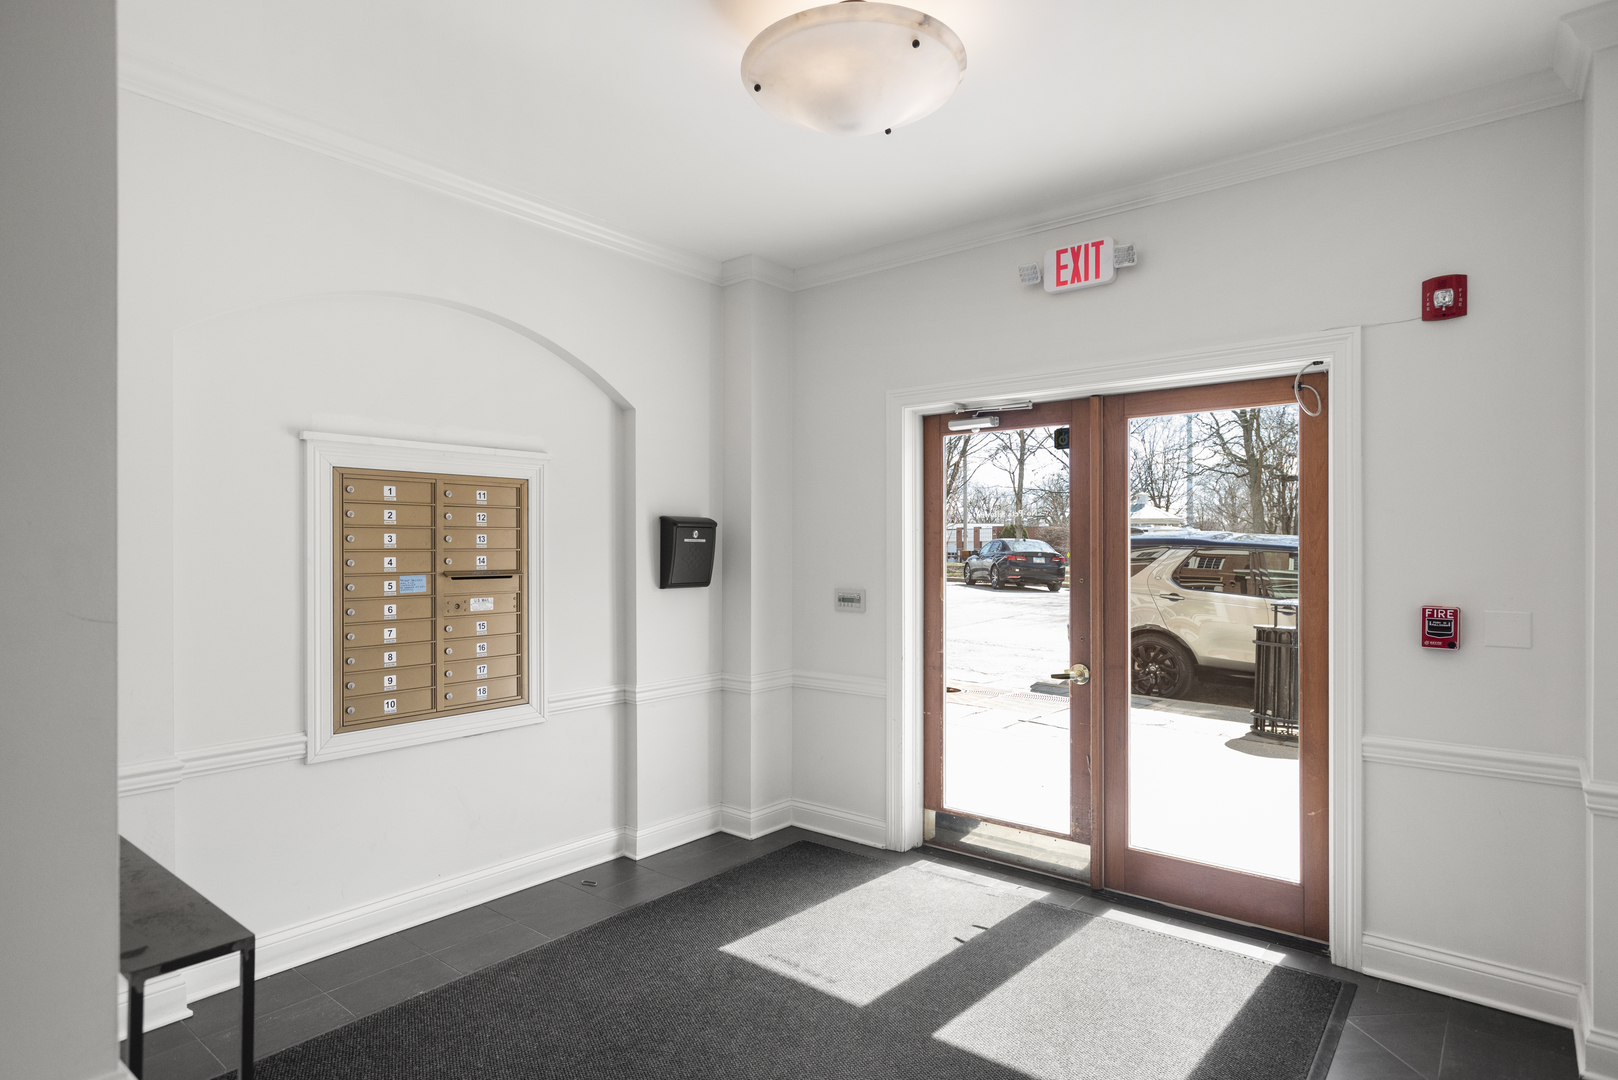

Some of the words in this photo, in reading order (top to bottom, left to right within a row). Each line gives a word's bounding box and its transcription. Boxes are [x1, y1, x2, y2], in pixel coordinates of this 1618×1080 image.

[1056, 240, 1104, 287] EXIT
[388, 606, 393, 614] 6
[1426, 609, 1454, 618] FIRE
